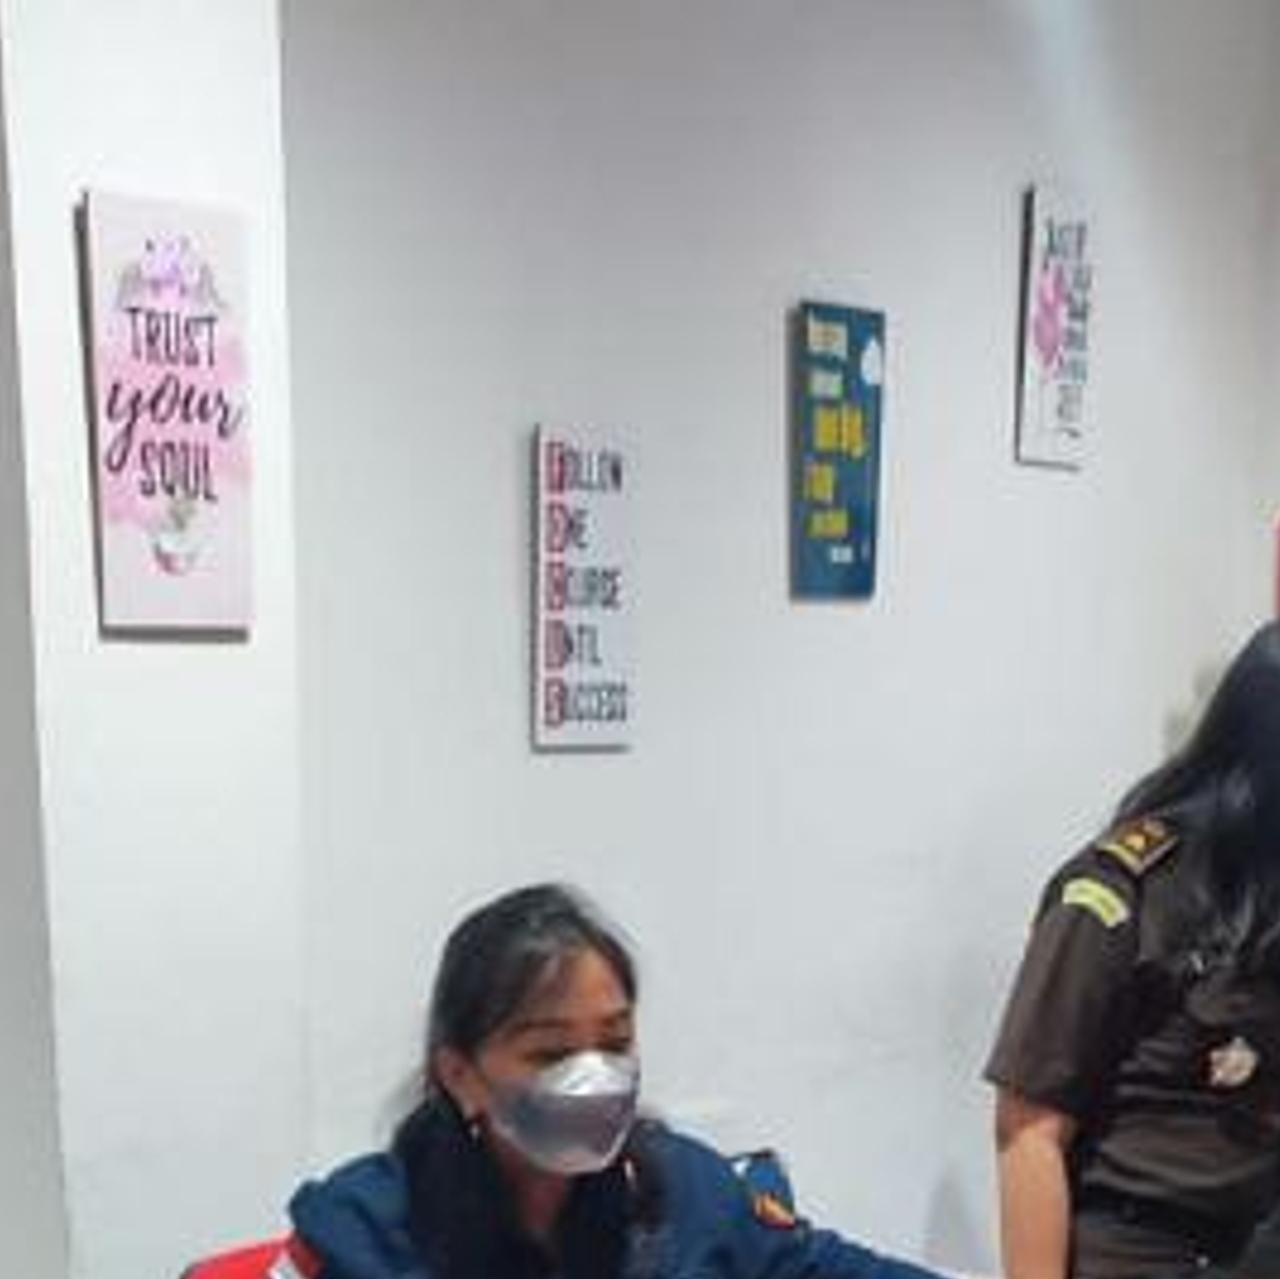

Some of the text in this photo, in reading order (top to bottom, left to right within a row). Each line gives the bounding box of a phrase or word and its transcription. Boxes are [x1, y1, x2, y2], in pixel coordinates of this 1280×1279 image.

[126, 306, 219, 367] TRUST
[106, 372, 243, 472] your
[138, 441, 218, 501] SOUL
